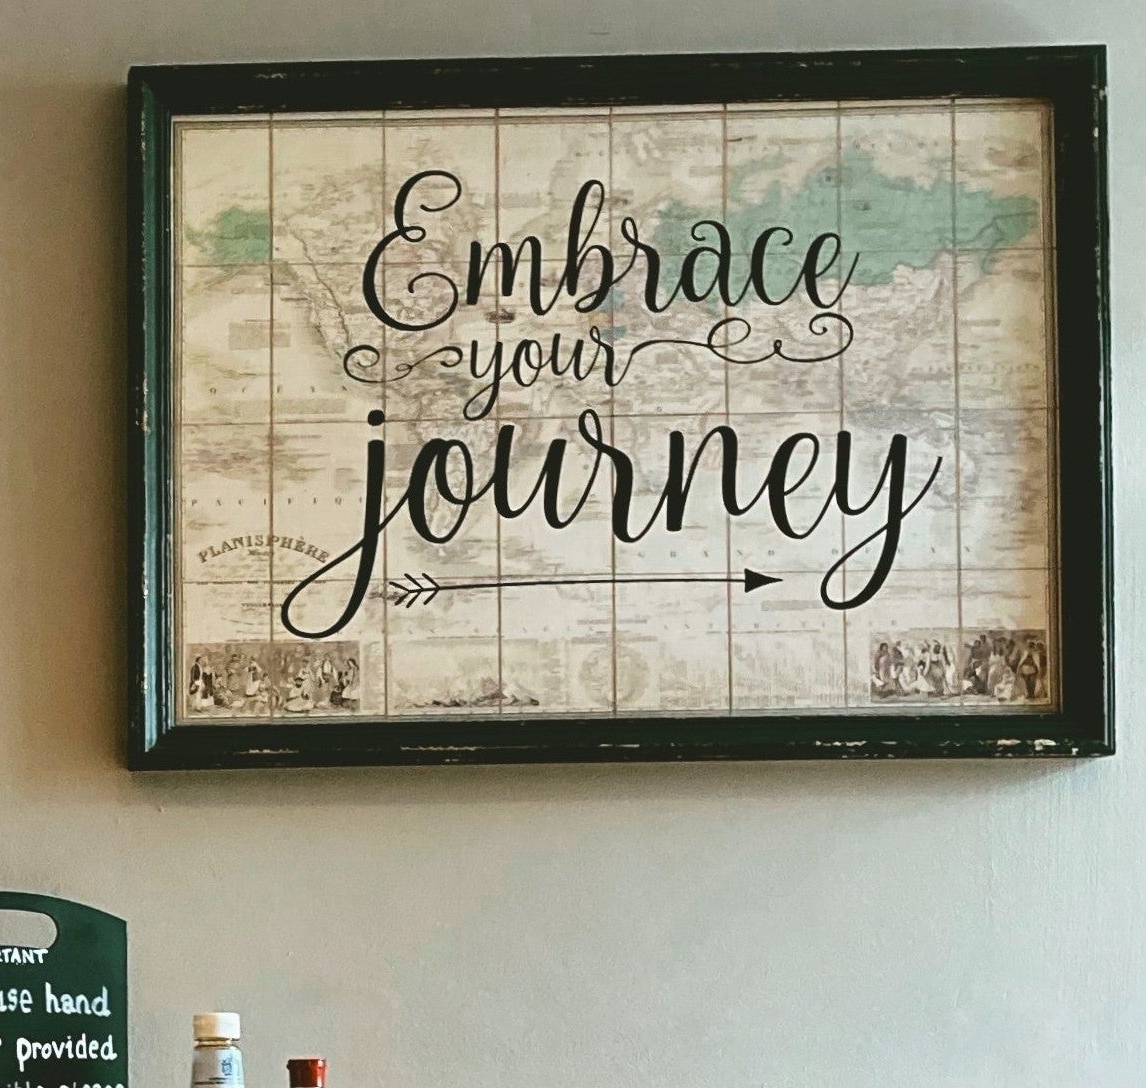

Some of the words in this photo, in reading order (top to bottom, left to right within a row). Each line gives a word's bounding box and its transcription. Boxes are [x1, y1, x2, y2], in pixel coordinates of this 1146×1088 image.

[362, 170, 860, 332] Embrace
[463, 325, 642, 421] your
[197, 534, 331, 564] PLANISPHÈRE
[281, 409, 943, 639] journey
[45, 981, 112, 1018] hand
[16, 1033, 118, 1073] provided
